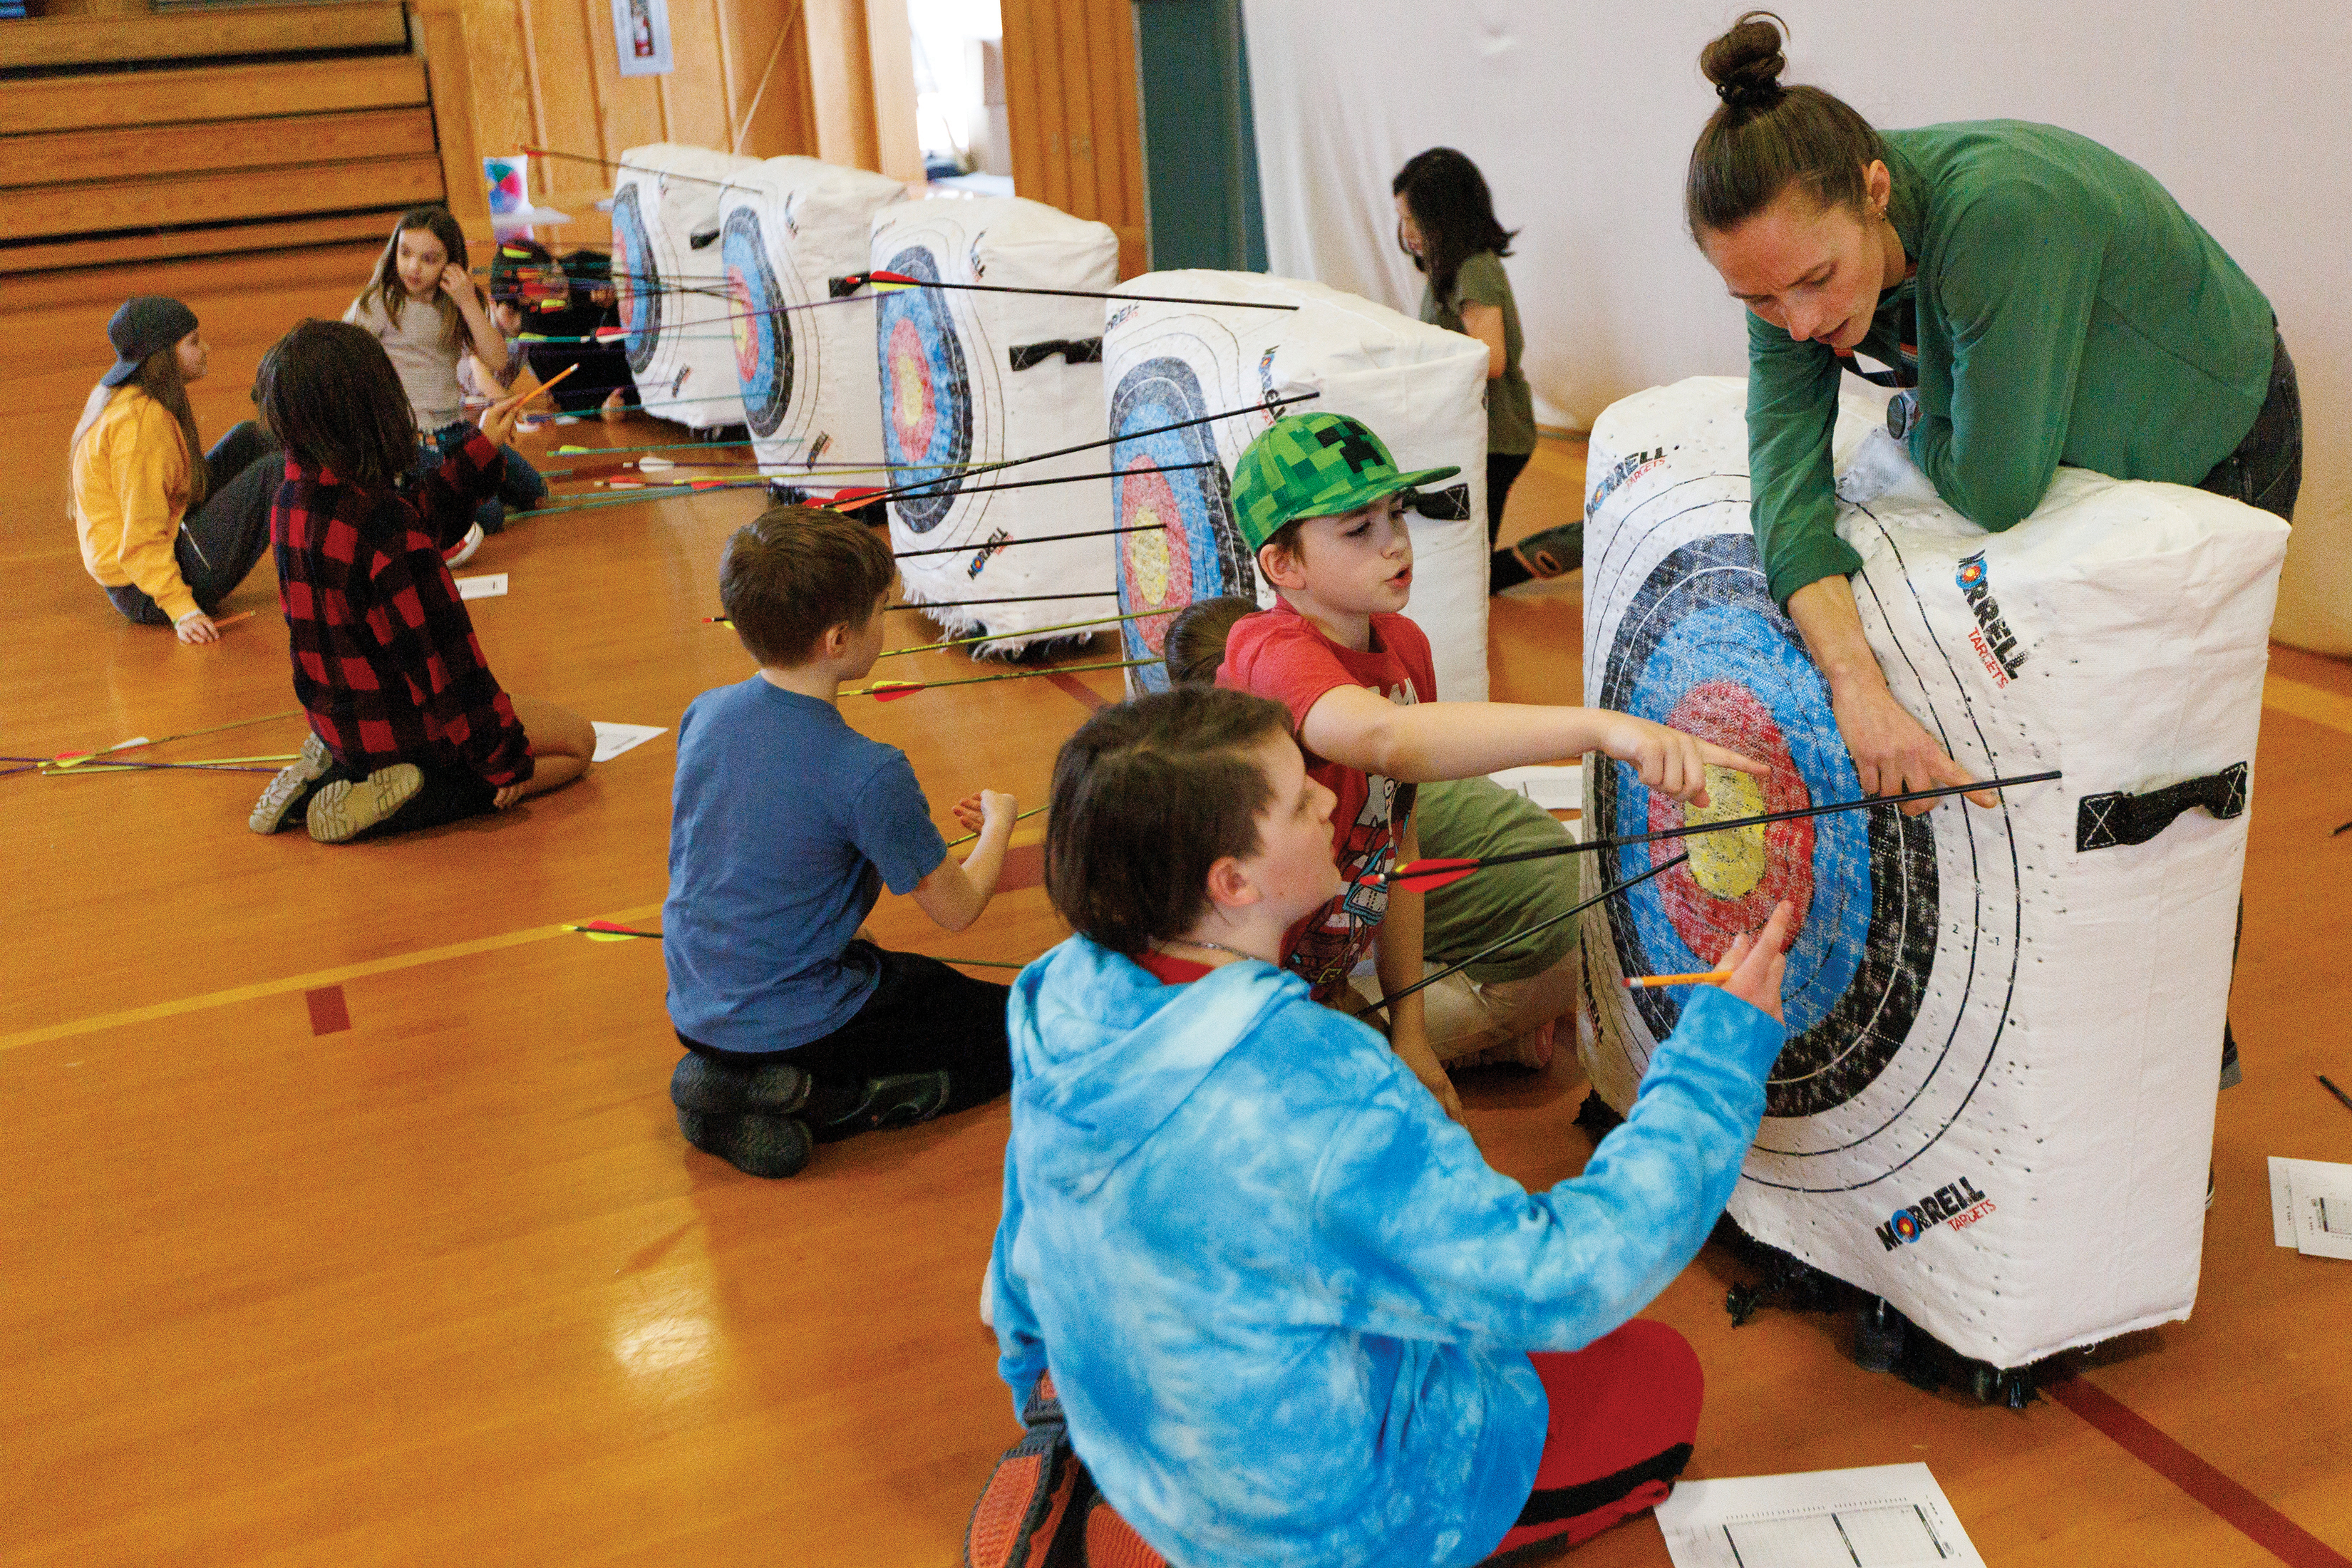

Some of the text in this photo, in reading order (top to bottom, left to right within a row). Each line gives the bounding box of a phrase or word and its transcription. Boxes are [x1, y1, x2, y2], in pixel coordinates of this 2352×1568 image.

[1968, 626, 2009, 689] TARGETS
[1952, 923, 1959, 934] 2
[1875, 1176, 1986, 1252] MORRELL
